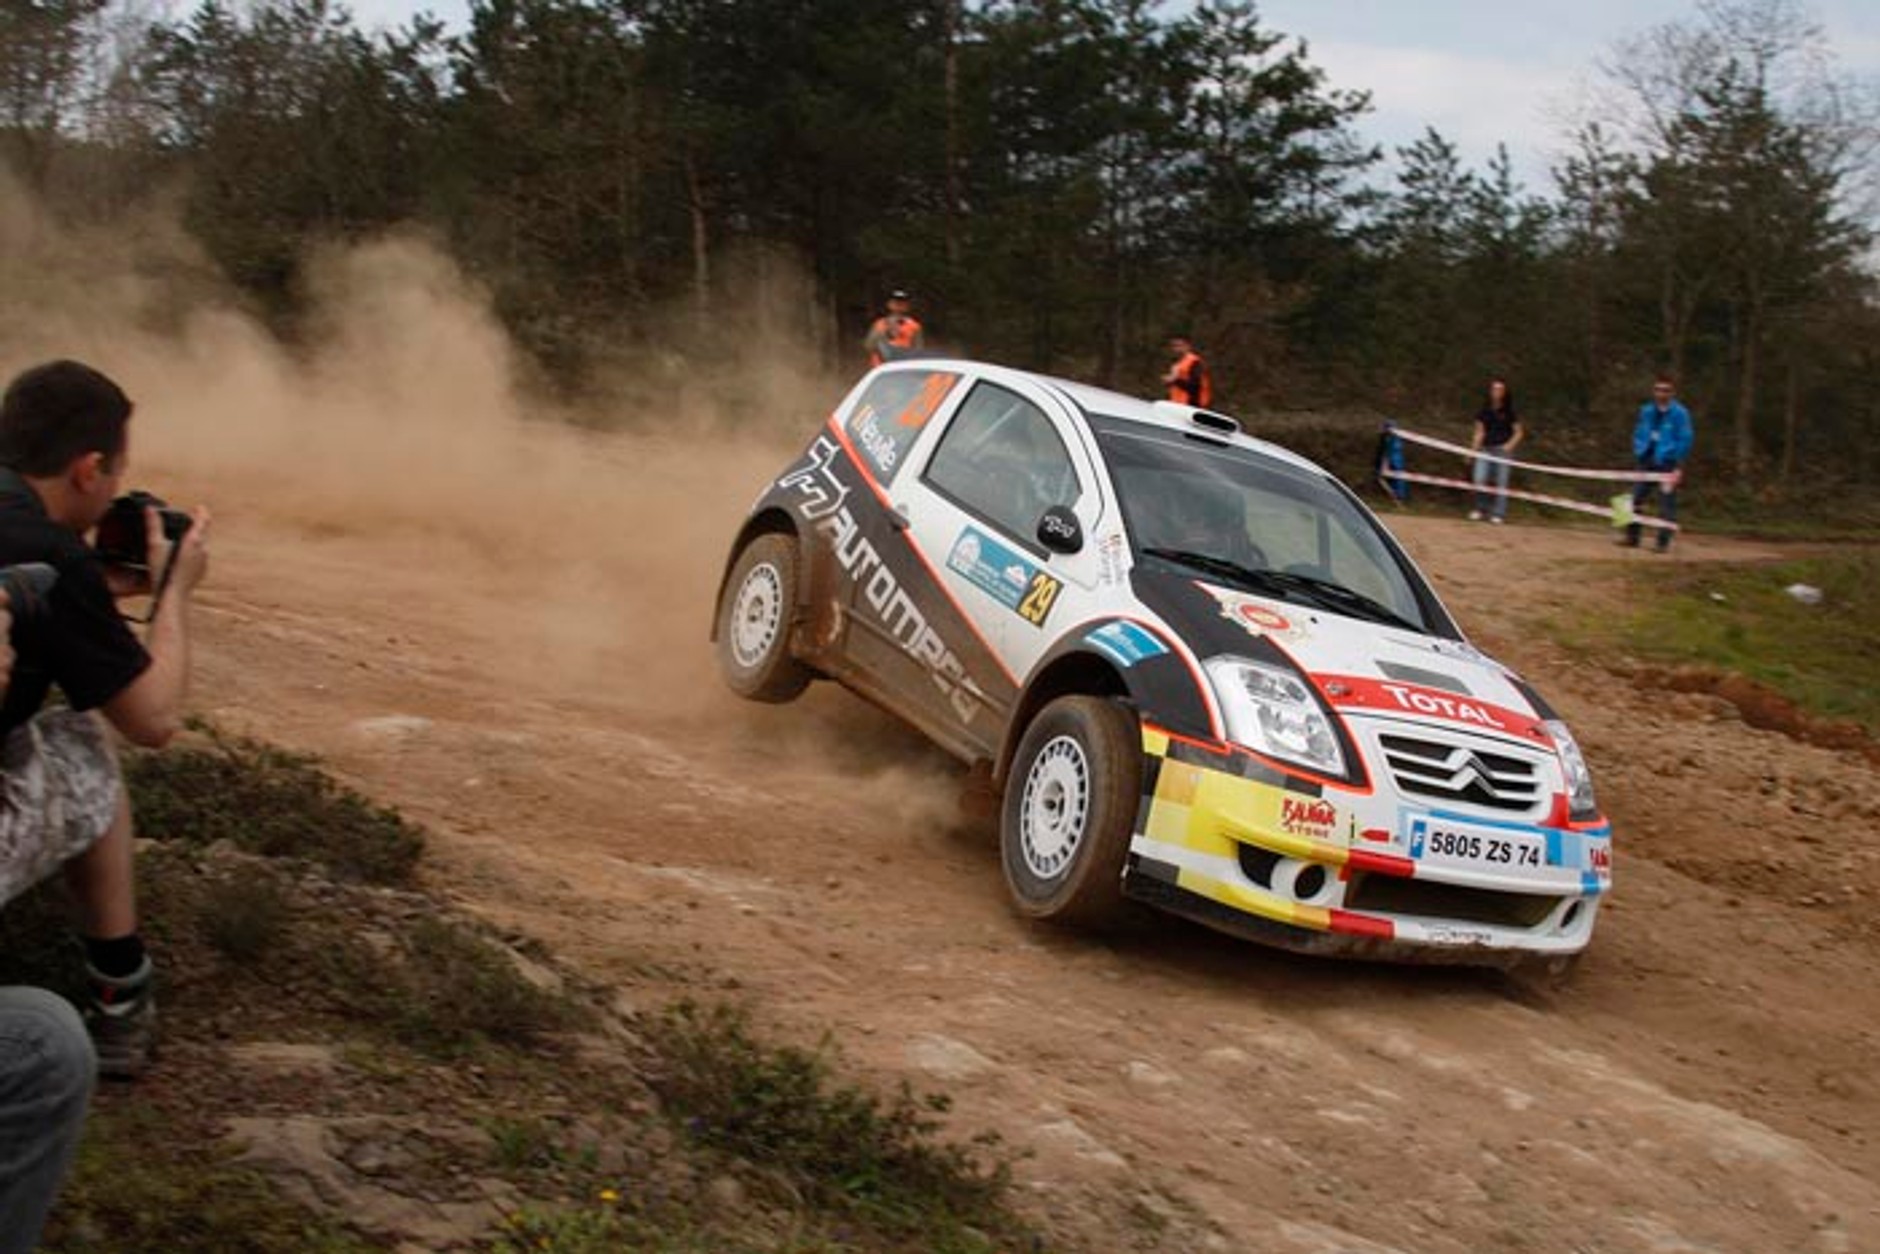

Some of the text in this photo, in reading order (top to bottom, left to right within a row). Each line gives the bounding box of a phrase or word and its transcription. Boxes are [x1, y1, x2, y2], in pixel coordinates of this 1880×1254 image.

[1018, 572, 1059, 624] 29
[1381, 684, 1505, 729] TOTAL
[1429, 832, 1541, 866] 5805 ZS 74
